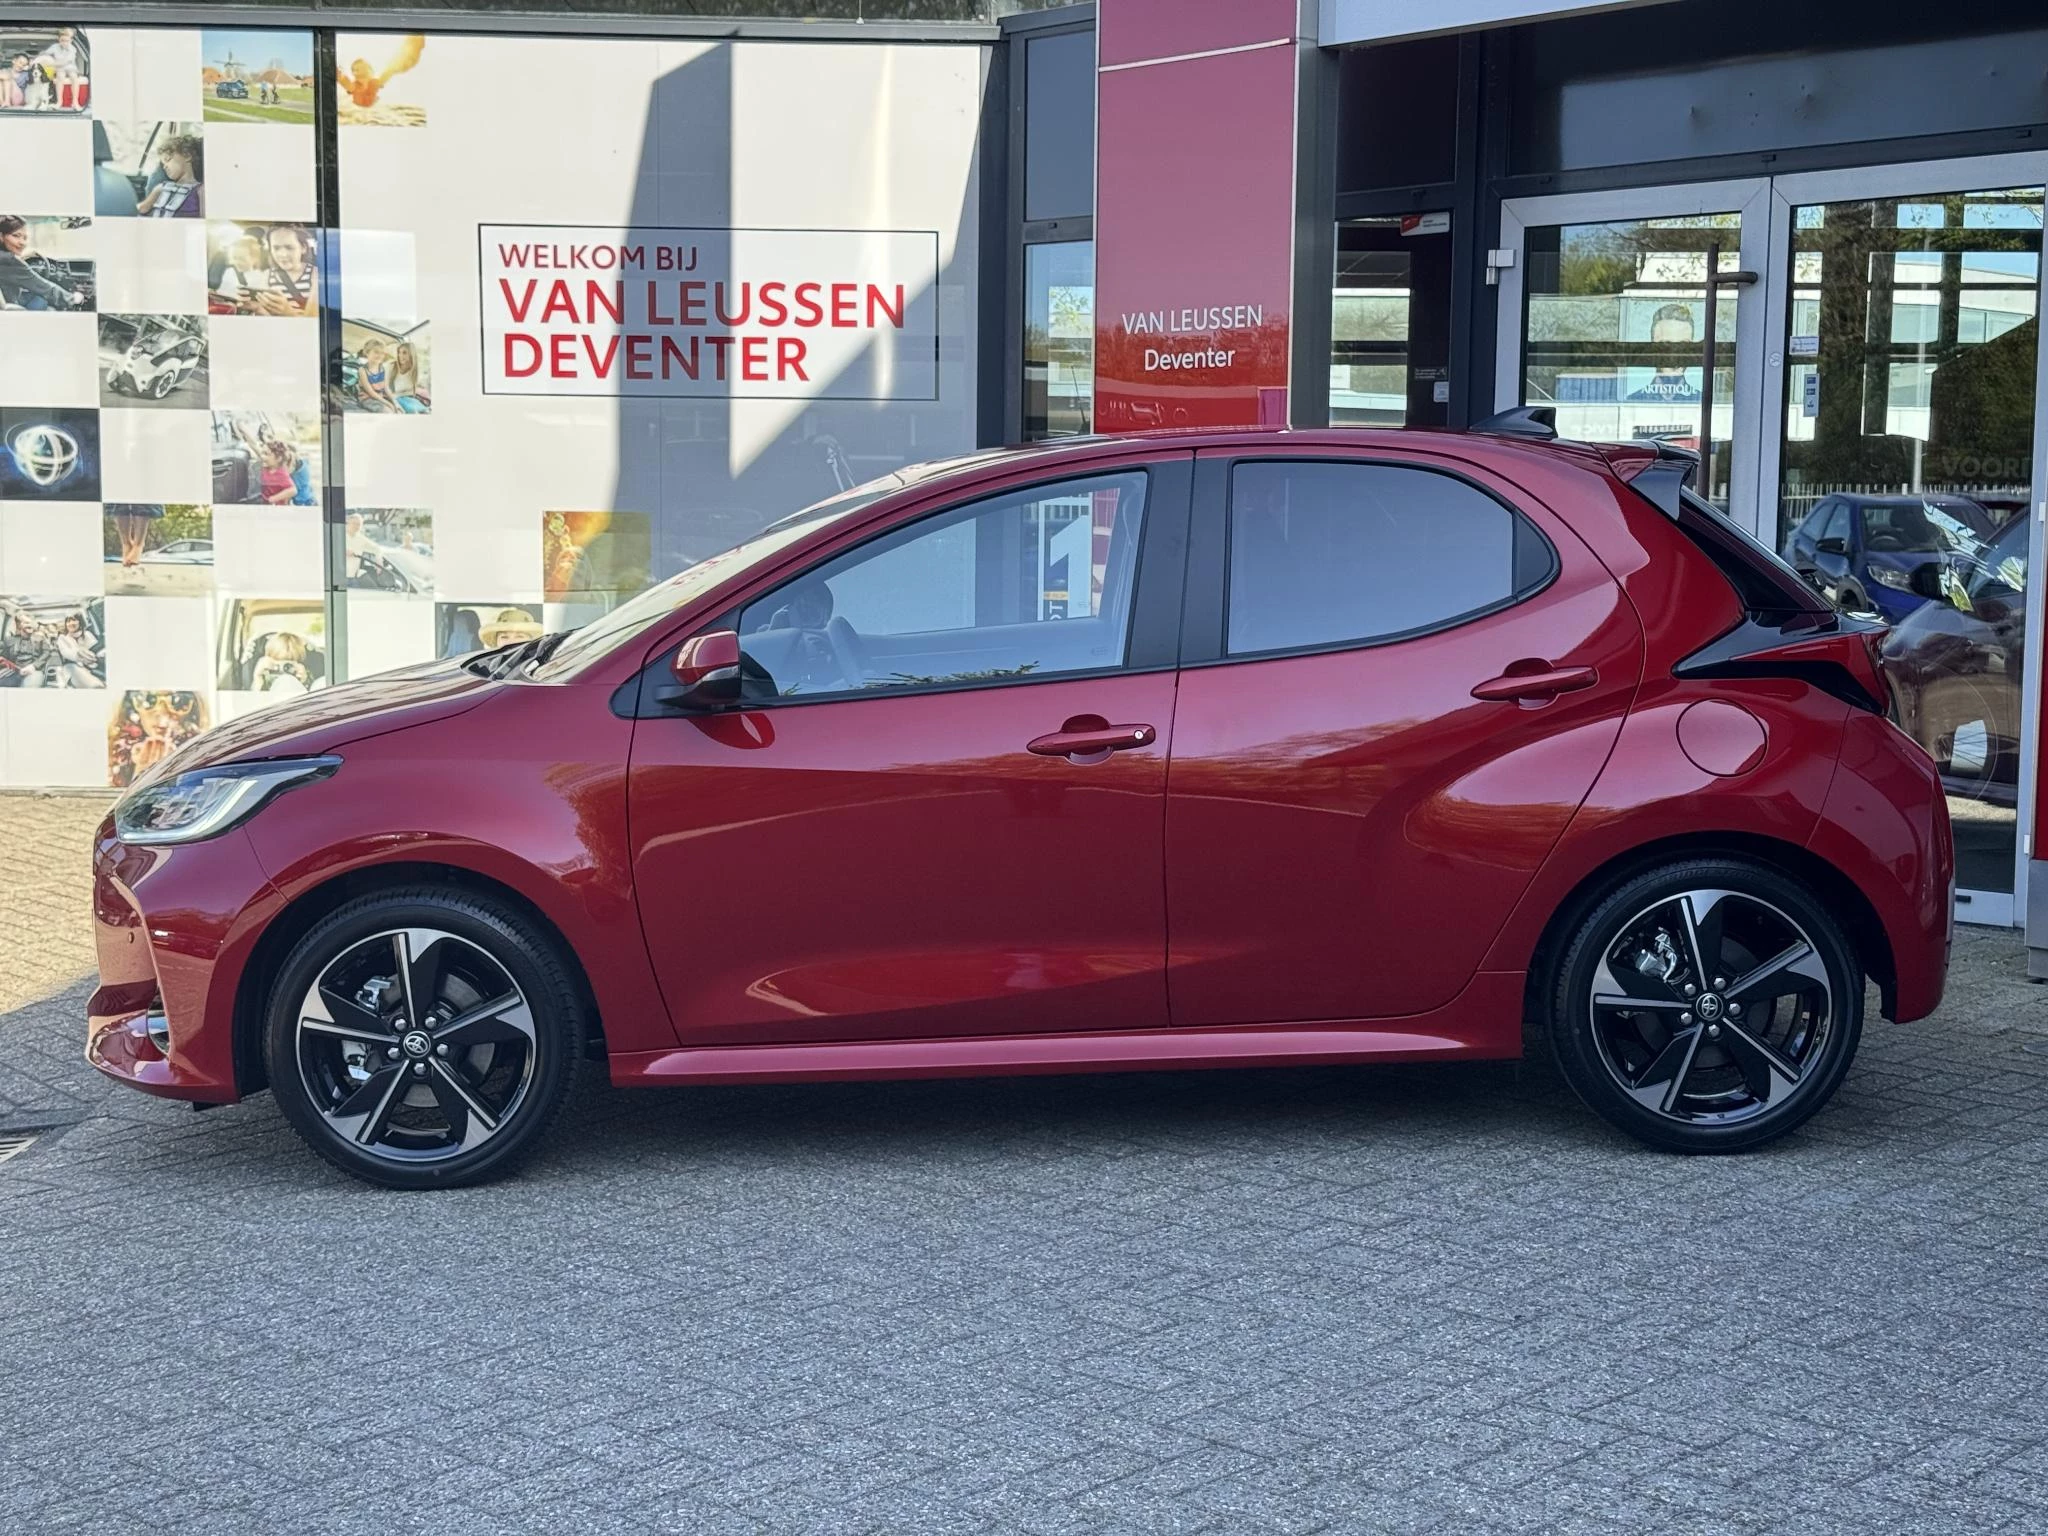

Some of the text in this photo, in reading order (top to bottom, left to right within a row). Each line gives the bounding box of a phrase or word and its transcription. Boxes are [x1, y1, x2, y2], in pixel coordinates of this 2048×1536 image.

[498, 243, 698, 272] WELKOM BIJ
[499, 279, 905, 329] VAN LEUSSEN
[1121, 304, 1263, 335] VAN LEUSSEN
[504, 332, 810, 382] DEVENTER
[1144, 347, 1236, 372] Deventer
